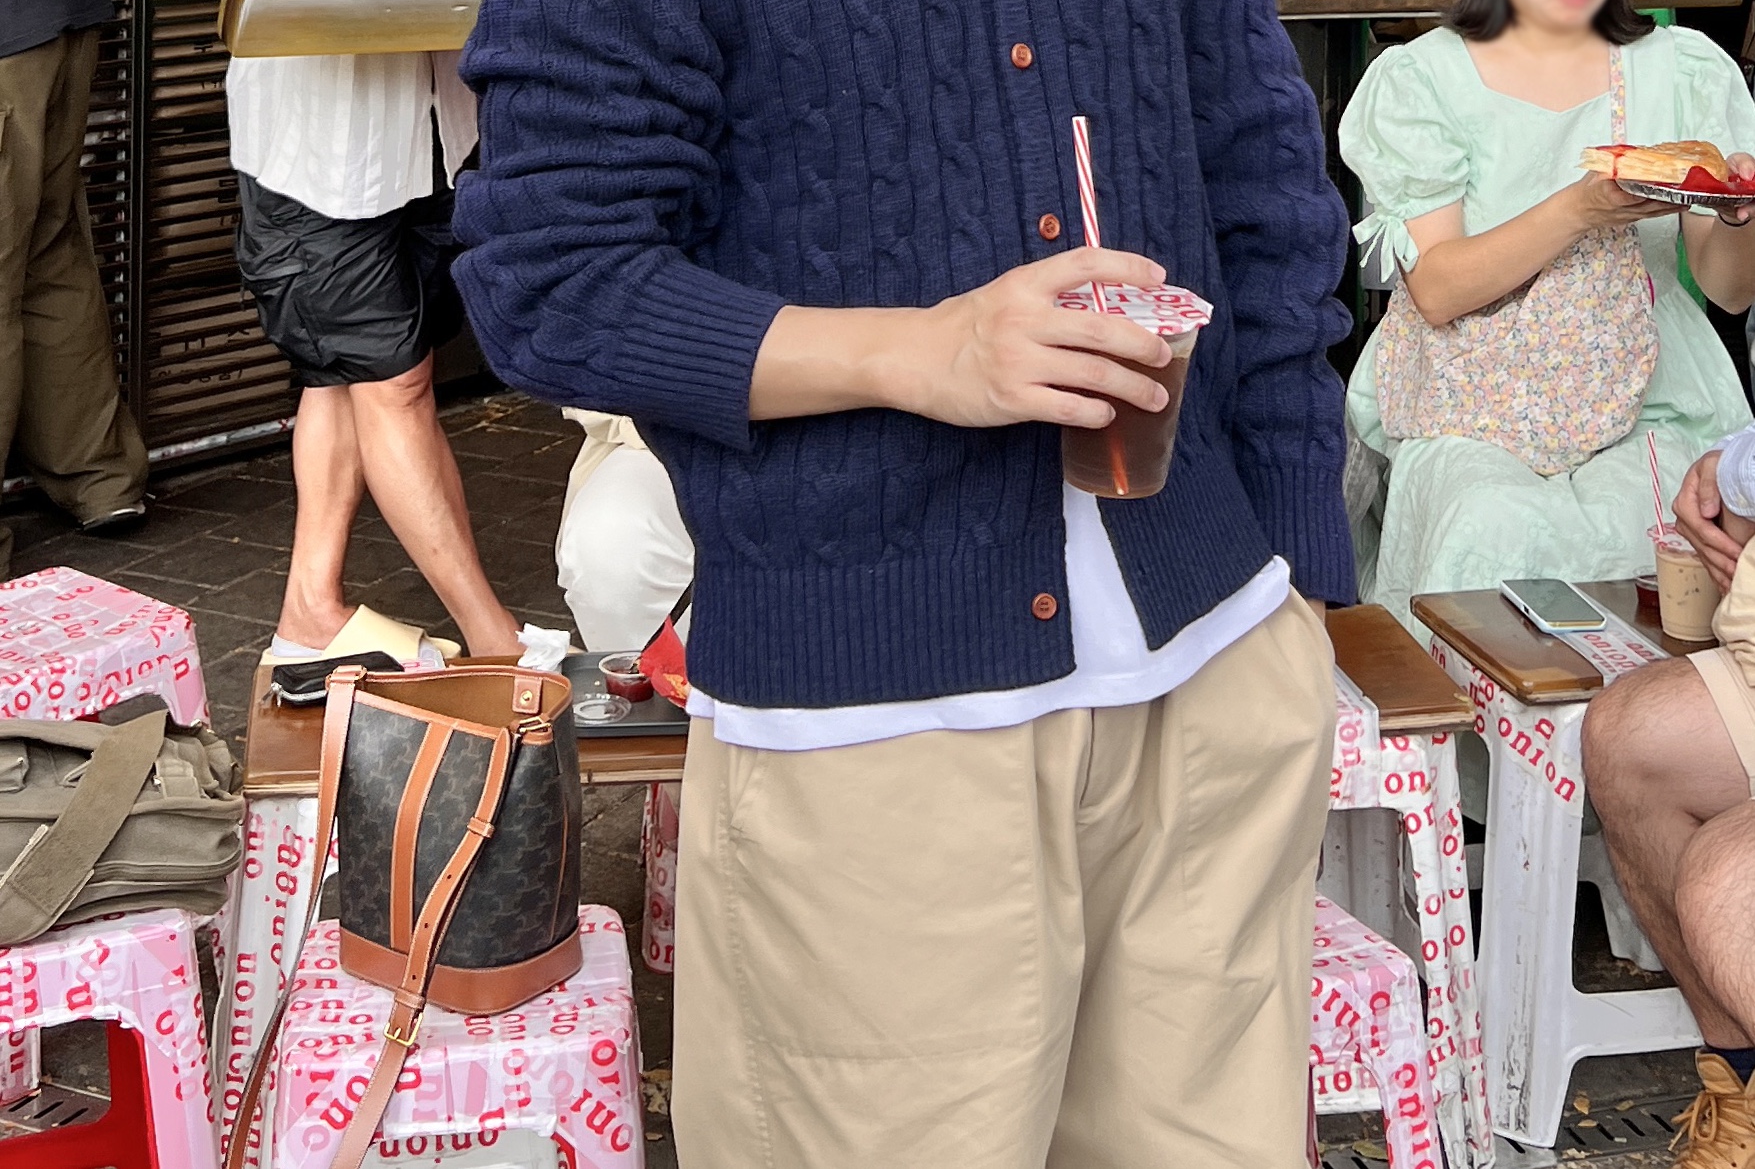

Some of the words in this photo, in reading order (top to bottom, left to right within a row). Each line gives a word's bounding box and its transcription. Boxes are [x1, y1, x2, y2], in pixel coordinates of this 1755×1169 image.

[1583, 634, 1638, 668] onion
[1498, 717, 1577, 802] onion
[228, 955, 257, 1074] onion
